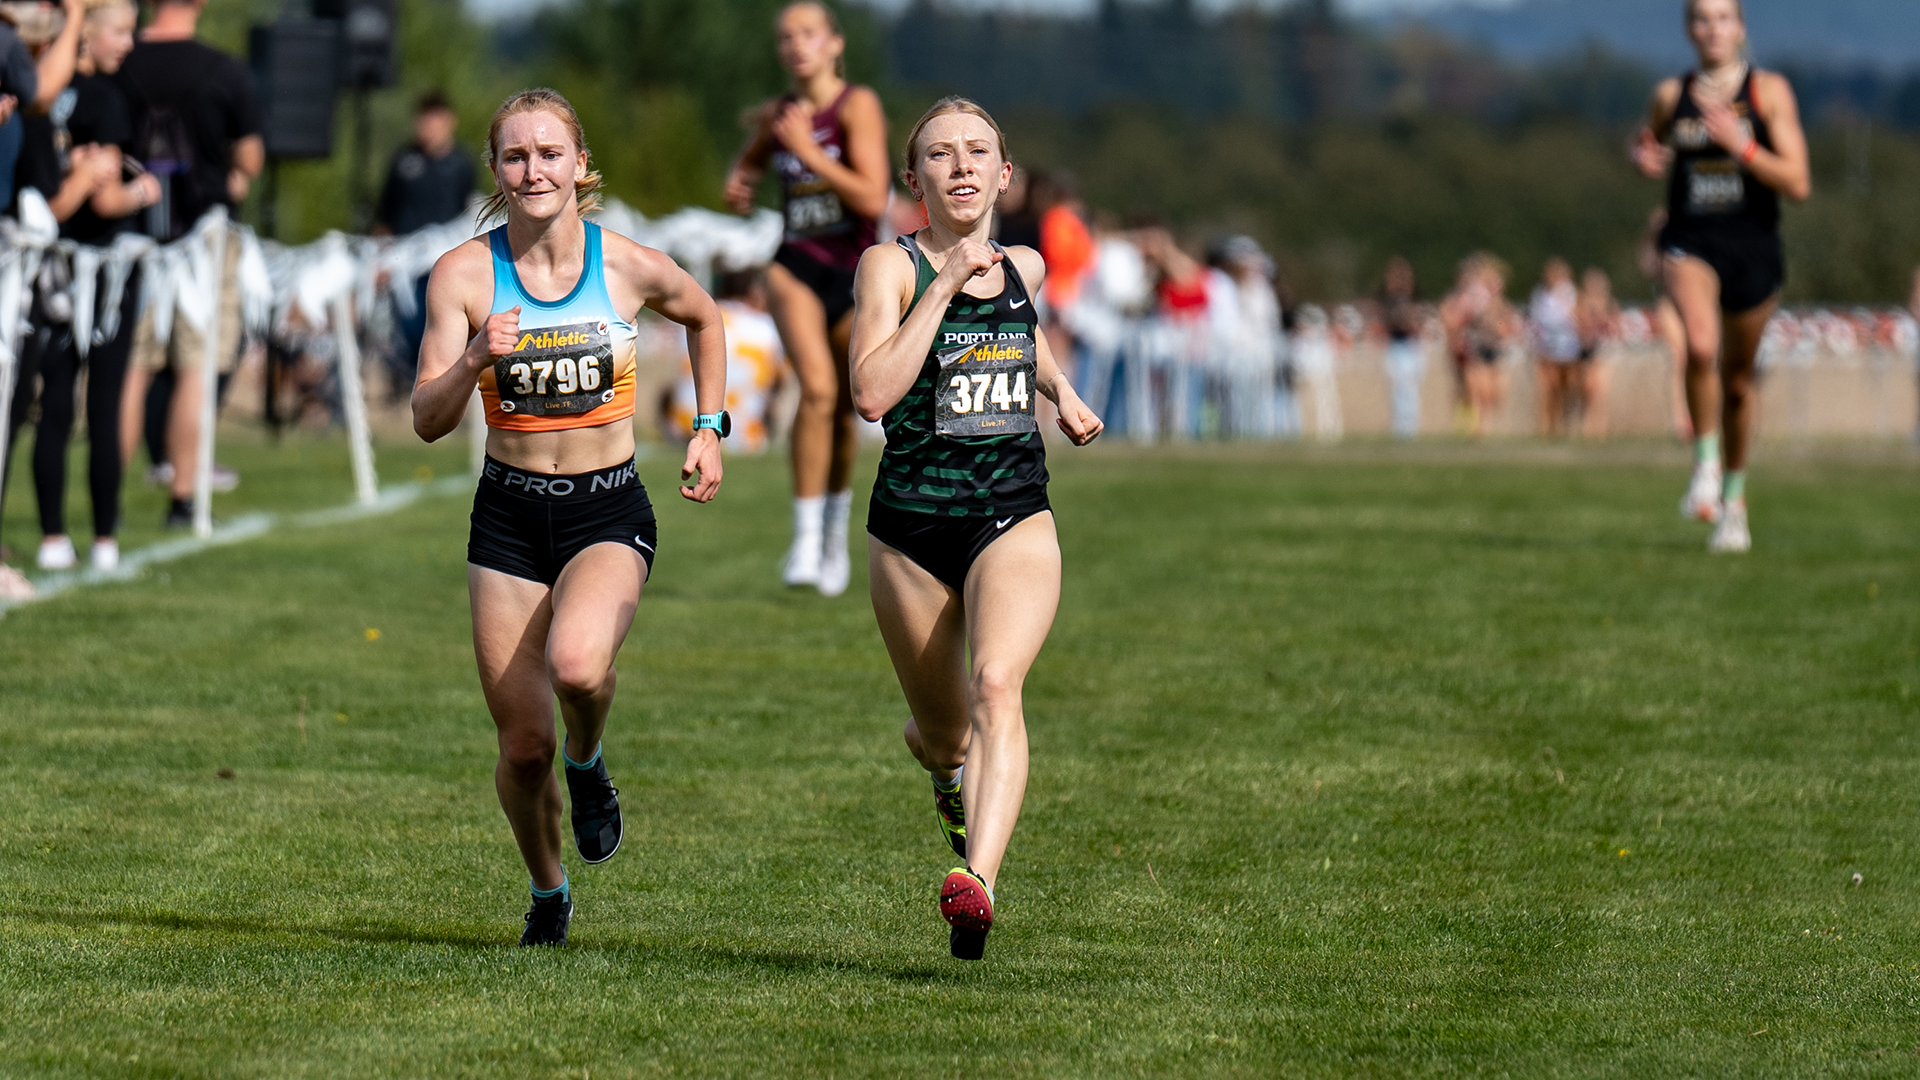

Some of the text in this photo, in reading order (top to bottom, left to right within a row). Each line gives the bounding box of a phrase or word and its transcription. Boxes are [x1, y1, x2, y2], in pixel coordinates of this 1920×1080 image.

[510, 355, 601, 395] 3796
[950, 371, 1029, 414] 3744
[981, 420, 1006, 428] Live.TF
[504, 470, 575, 496] PRO
[590, 460, 636, 493] NIK
